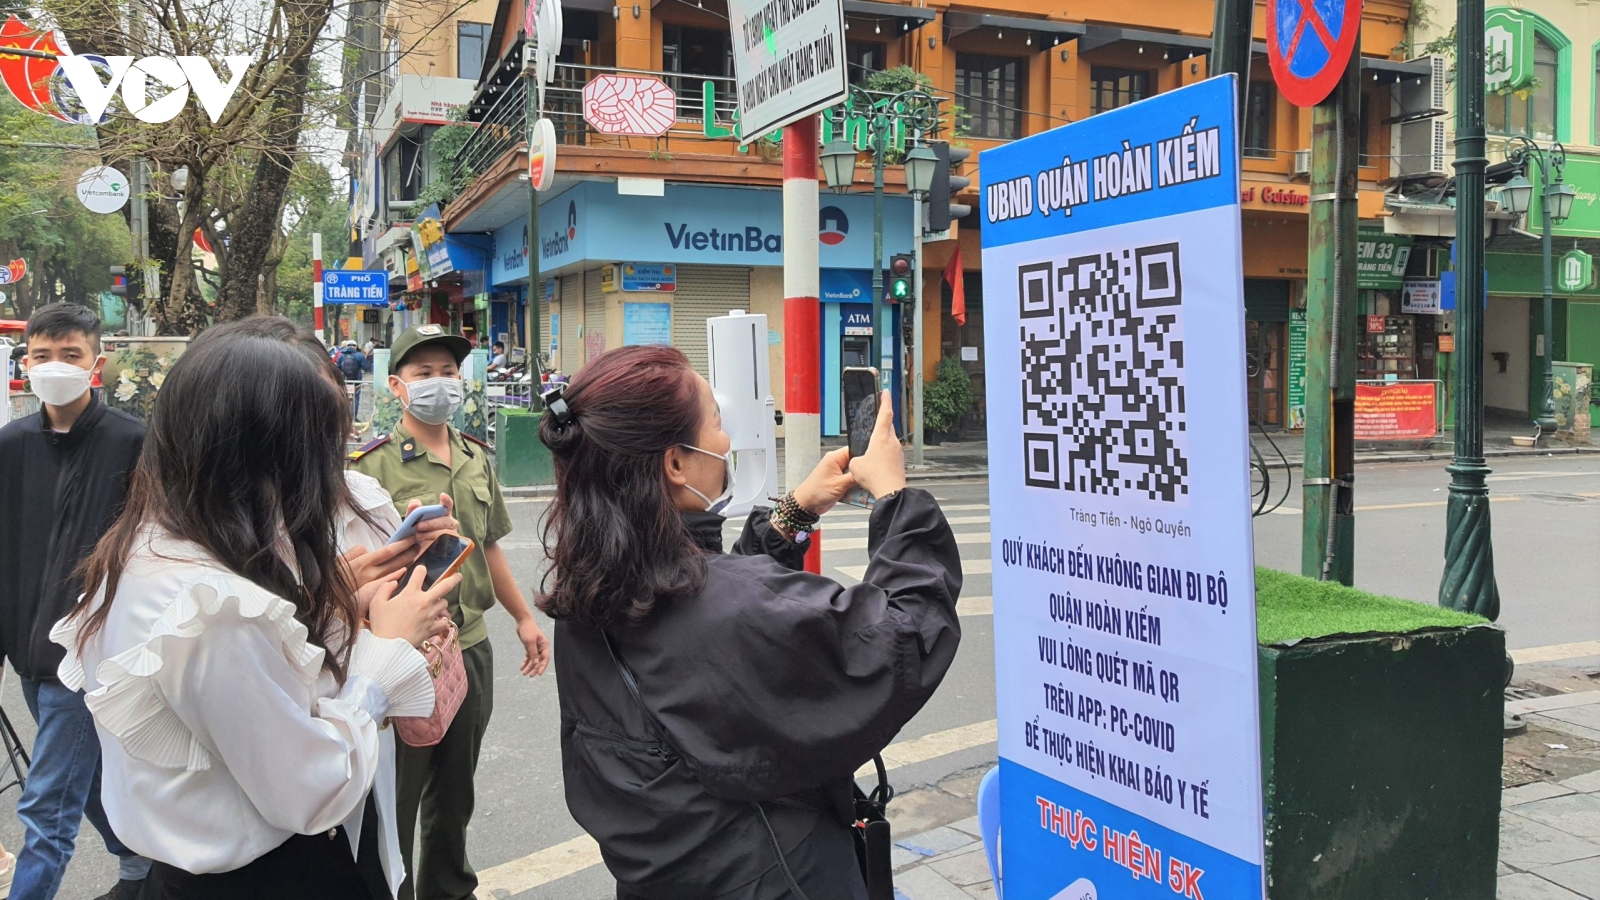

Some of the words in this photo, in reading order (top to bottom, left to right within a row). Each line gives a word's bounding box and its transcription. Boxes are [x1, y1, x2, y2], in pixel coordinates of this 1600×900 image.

[795, 41, 814, 84] HÀNG
[814, 24, 835, 75] TUẦN
[987, 174, 1033, 224] UBND
[1037, 156, 1089, 217] QUẬN
[1093, 140, 1152, 201] HOÀN
[1157, 115, 1220, 188] KIẾM
[351, 274, 371, 282] PHỐ
[1358, 241, 1376, 258] EM
[1376, 242, 1394, 259] 33
[328, 284, 360, 298] TRÀNG
[848, 314, 870, 323] ATM
[1070, 508, 1097, 527] Tràng
[1100, 510, 1121, 527] Tiền
[1131, 515, 1152, 534] Ngô
[1155, 518, 1191, 538] Quyền
[1002, 536, 1023, 567] QUÝ
[1026, 540, 1065, 575] KHÁCH
[1068, 544, 1093, 581] ĐẾN
[1097, 553, 1143, 591] KHÔNG
[1147, 564, 1182, 599] GIAN
[1186, 571, 1202, 603] ĐI
[1206, 570, 1228, 615] BỘ
[1049, 591, 1083, 629] QUẬN
[1086, 599, 1121, 636] HOÀN
[1125, 605, 1162, 646] KIẾM
[1038, 635, 1057, 666] VUI
[1061, 637, 1092, 677] LÒNG
[1096, 651, 1128, 687] QUÉT
[1132, 661, 1156, 695] MÃ
[1159, 669, 1180, 703] QR
[1044, 682, 1074, 718] TRÊN
[1077, 694, 1107, 730] APP:
[1110, 704, 1175, 753] PC-COVID
[1025, 715, 1040, 751] ĐỂ
[1042, 727, 1073, 766] THỰC
[1076, 740, 1105, 779] HIỆN
[1109, 753, 1140, 792] KHAI
[1144, 764, 1173, 805] BÁO
[1177, 778, 1187, 810] Y
[1191, 779, 1210, 820] TẾ
[1036, 795, 1097, 851] THỰC
[1102, 826, 1162, 885] HIỆN
[1168, 857, 1205, 900] 5K
